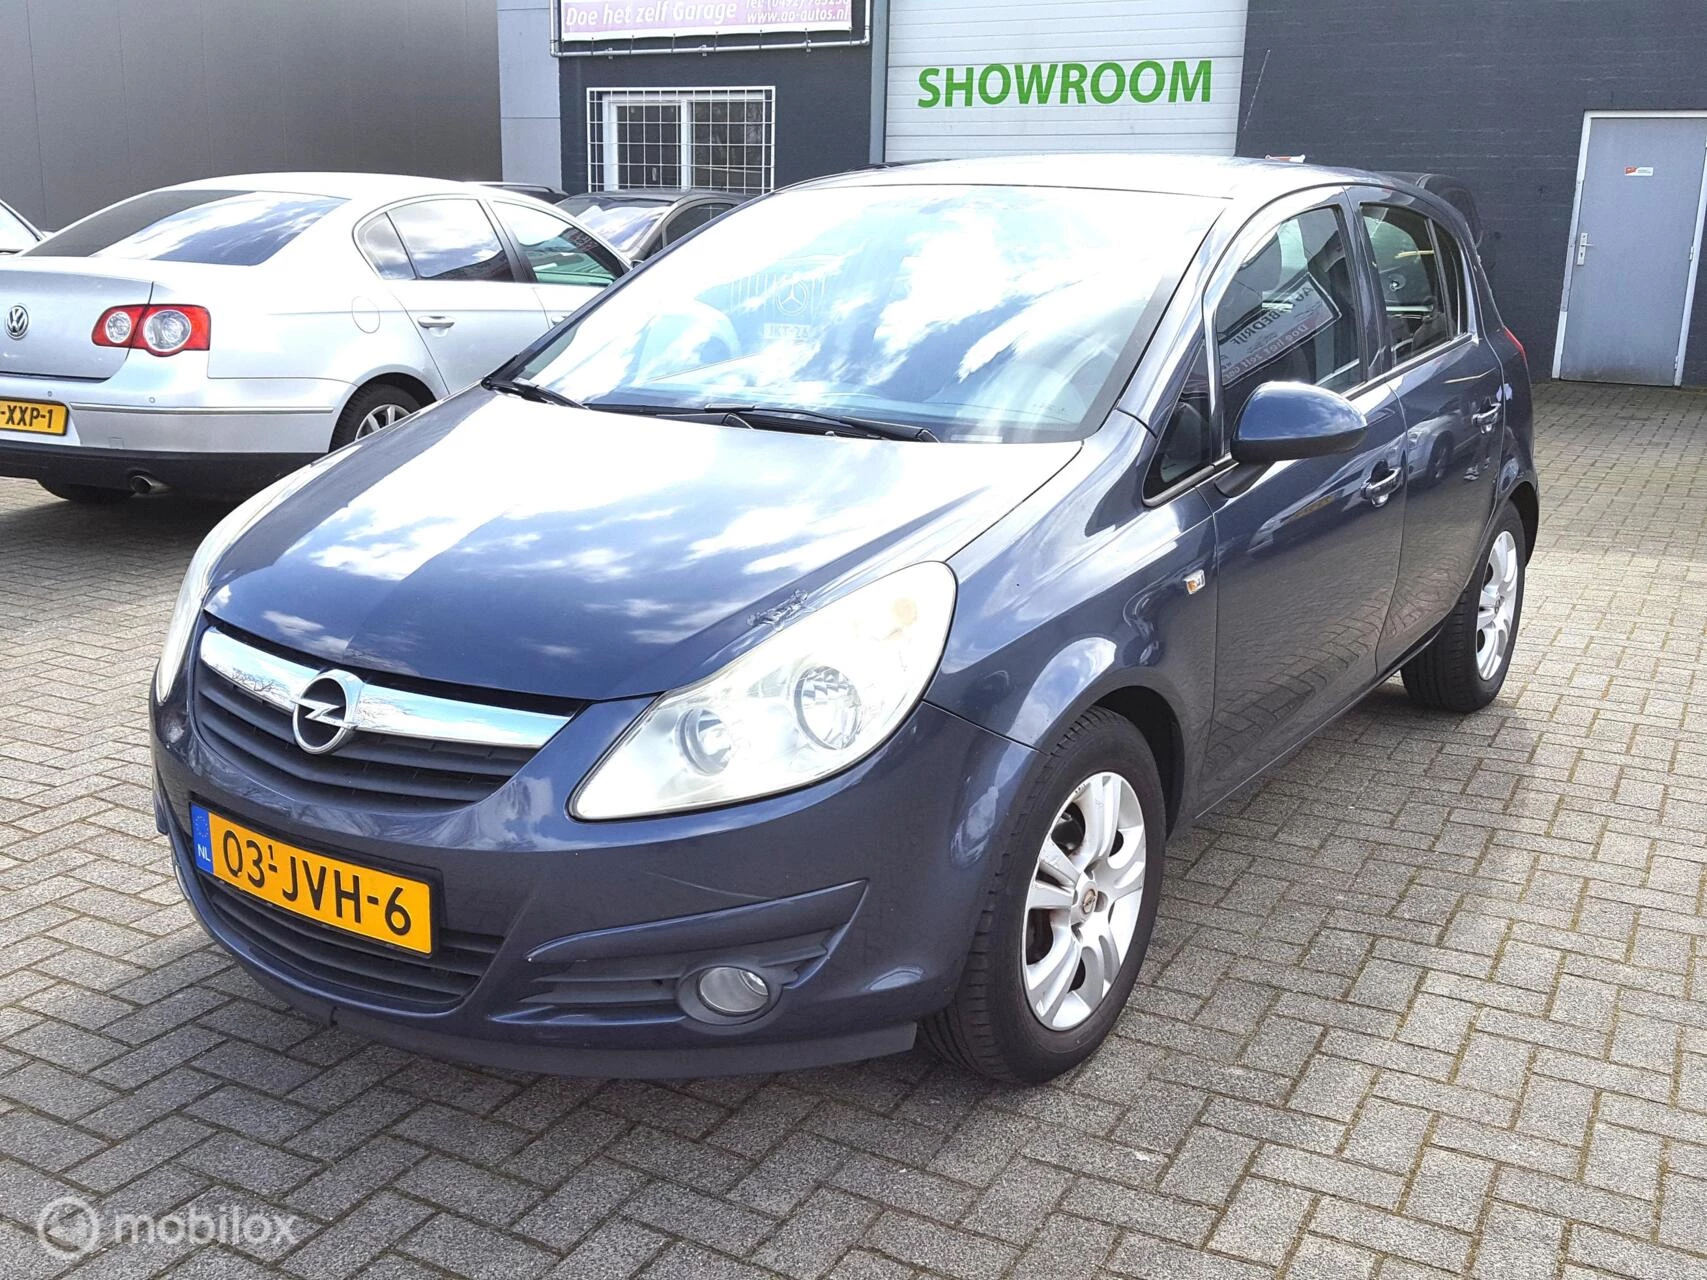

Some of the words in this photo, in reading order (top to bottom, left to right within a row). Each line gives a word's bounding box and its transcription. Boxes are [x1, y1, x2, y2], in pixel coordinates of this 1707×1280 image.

[566, 7, 598, 27] Doe
[603, 4, 633, 25] het
[636, 0, 671, 23] zelf
[673, 2, 738, 25] Garage
[917, 59, 1213, 108] SHOWROOM
[197, 843, 211, 862] NL
[223, 830, 412, 936] 03-JVH-6
